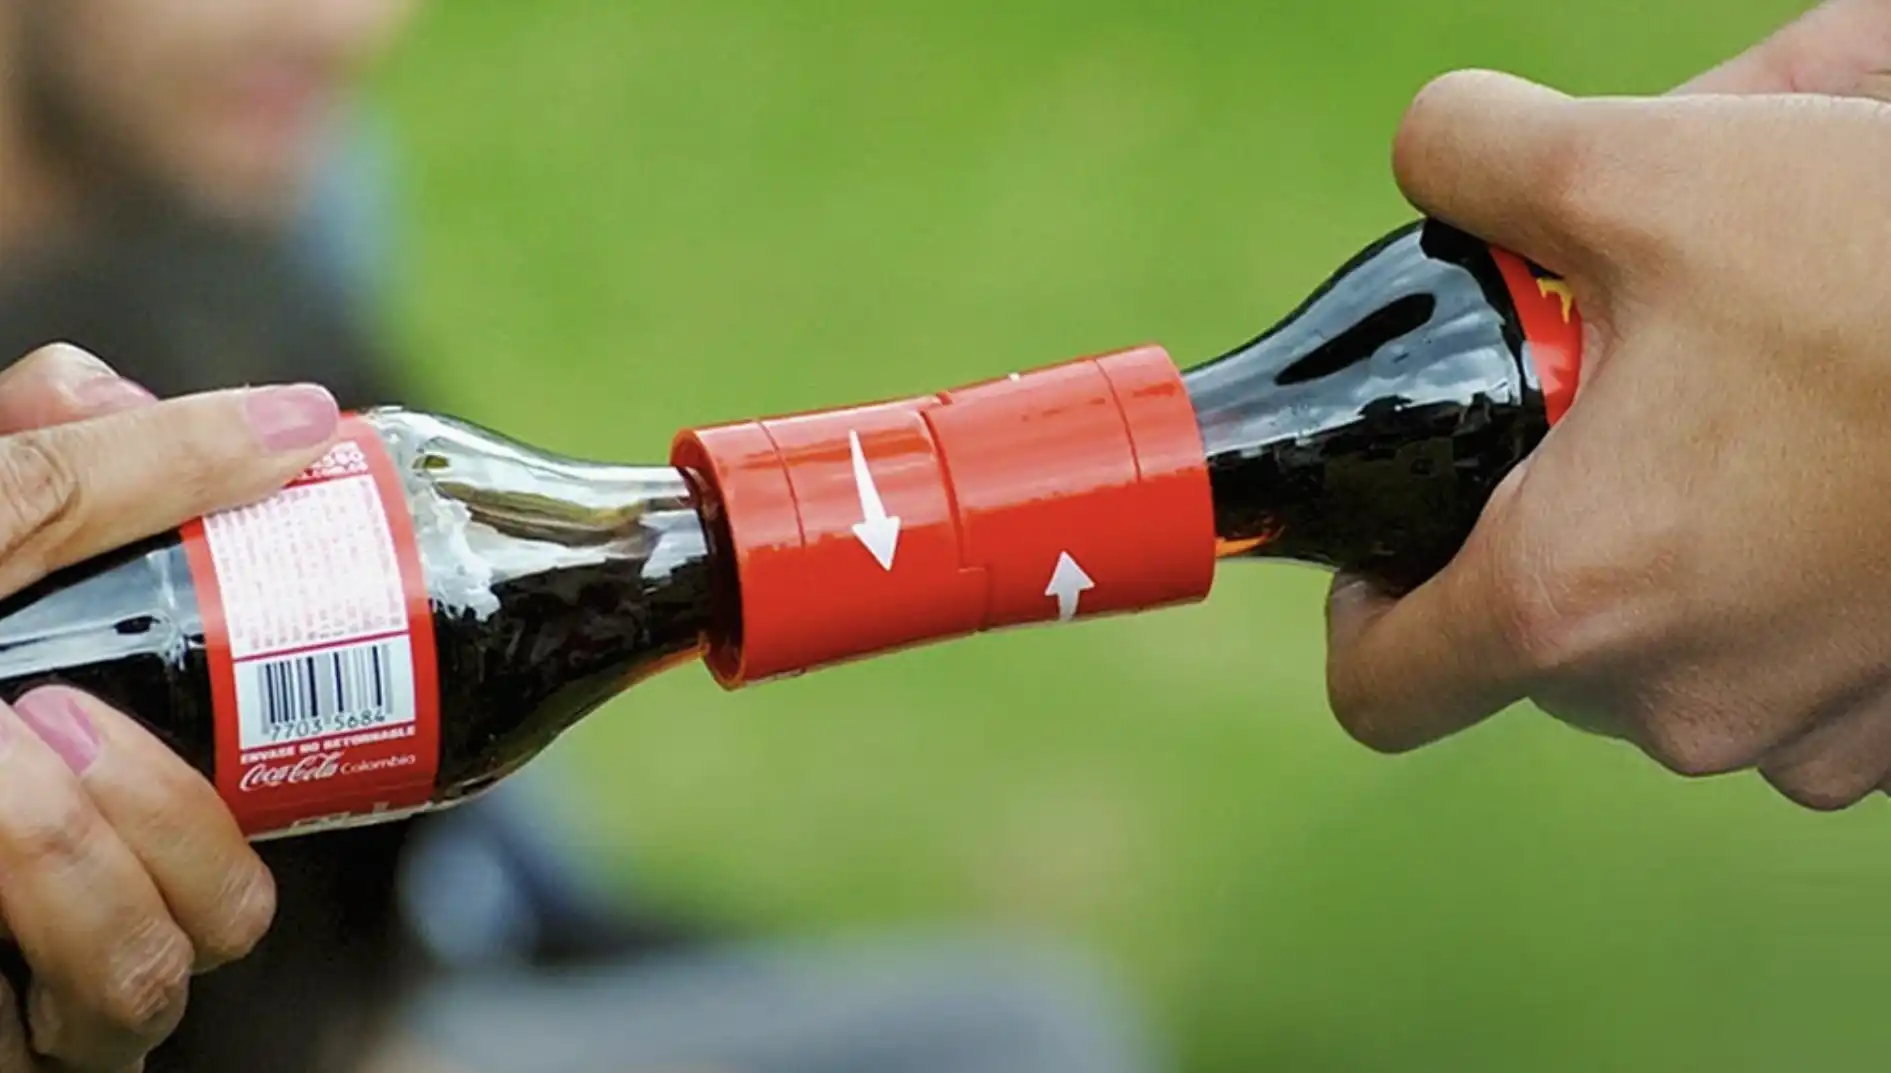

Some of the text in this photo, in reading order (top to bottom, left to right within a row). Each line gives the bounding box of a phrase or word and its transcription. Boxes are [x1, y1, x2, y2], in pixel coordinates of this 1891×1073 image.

[271, 719, 323, 741] 7703
[299, 742, 321, 754] NO
[322, 724, 417, 750] RETORNABLE
[339, 753, 417, 776] Colombia
